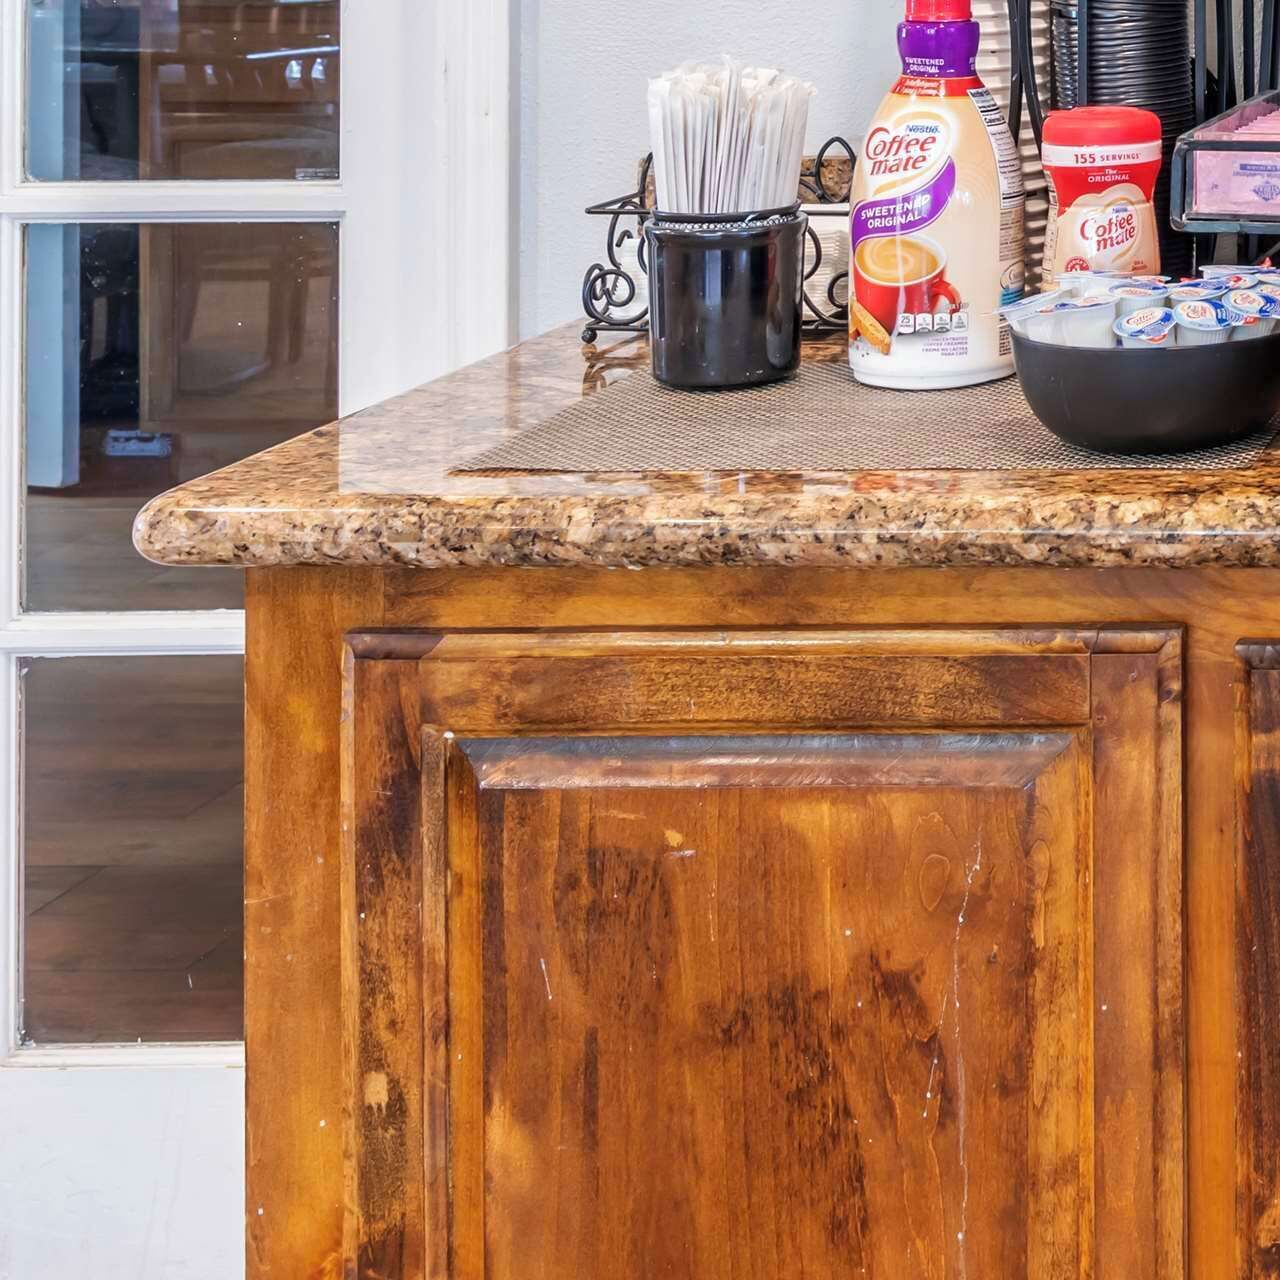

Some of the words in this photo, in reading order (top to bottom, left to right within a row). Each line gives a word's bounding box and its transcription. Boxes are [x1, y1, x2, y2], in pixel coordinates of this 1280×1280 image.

[905, 56, 945, 66] SWEETENED
[909, 64, 940, 73] ORIGINAL
[866, 127, 936, 160] Coffee
[870, 155, 927, 176] mate
[1074, 153, 1096, 164] 155
[1100, 153, 1139, 162] SERVINGS
[1088, 174, 1130, 182] ORIGINAL
[861, 194, 930, 219] SWEETENED
[867, 211, 922, 228] ORIGINAL
[1080, 213, 1134, 240] Coffee
[1096, 226, 1136, 252] mate
